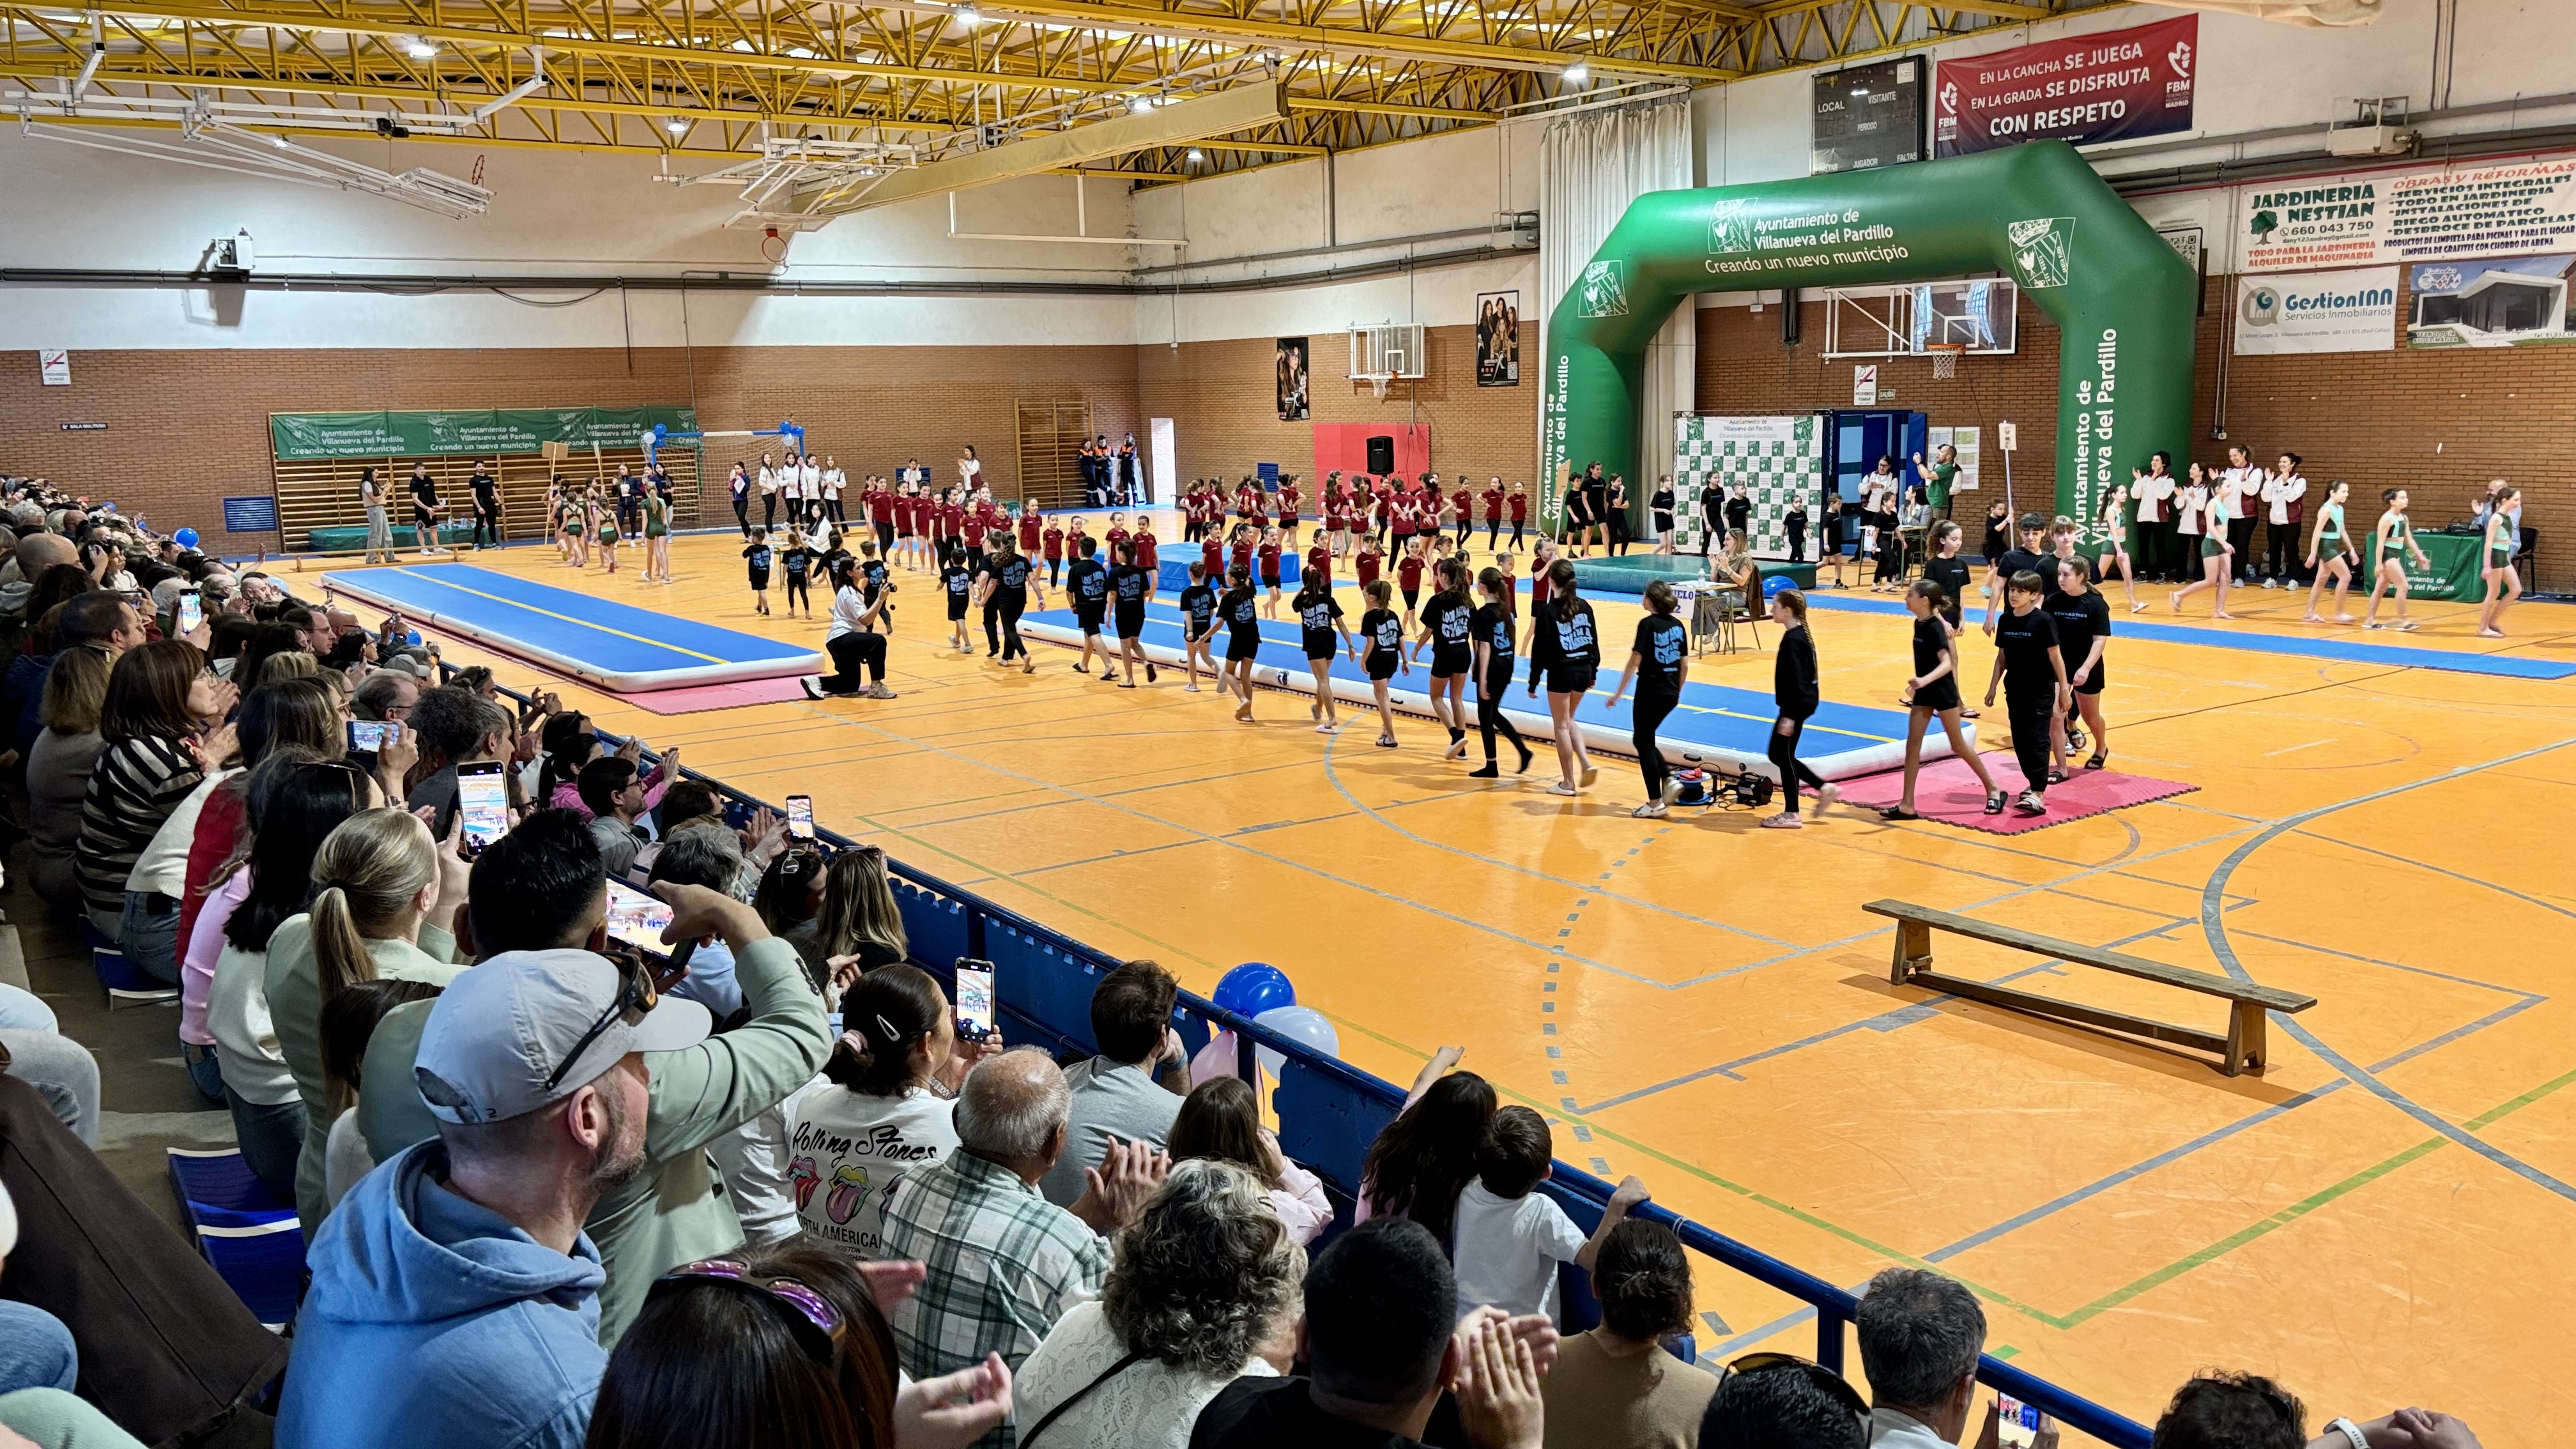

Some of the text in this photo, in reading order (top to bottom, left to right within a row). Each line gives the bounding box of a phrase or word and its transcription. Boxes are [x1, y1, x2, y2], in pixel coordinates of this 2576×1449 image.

[1980, 42, 2143, 84] EN LA CANCHA SE JUEGA
[1971, 66, 2150, 110] EN LA GRADA SE DISFRUTA
[2166, 79, 2190, 94] FBM
[1867, 91, 1896, 104] VISITANTE
[2165, 100, 2189, 108] MADRID
[1818, 100, 1846, 114] LOCAL
[1857, 121, 1878, 132] PERIODO
[1938, 116, 1957, 128] FBM
[1990, 99, 2126, 136] CON RESPETO
[1853, 158, 1878, 169] JUGADOR
[1896, 151, 1918, 162] FALTAS
[2393, 175, 2451, 189] OBRAS
[2472, 163, 2575, 181] REFORMAS
[2478, 174, 2572, 190] INTEGRALES
[2251, 184, 2375, 210] JARDINERIA
[2441, 194, 2459, 203] EN
[2462, 186, 2554, 201] JARDINERIA
[2512, 197, 2533, 206] DE
[1754, 208, 1860, 234] Ayuntamiento de
[2288, 201, 2375, 223] NESTIAN
[2393, 207, 2545, 227] RIEGO AUTOMATICO
[2474, 220, 2492, 229] DE
[2496, 213, 2575, 227] PARCELAS
[1753, 234, 1817, 250] Villanueva
[1820, 229, 1840, 245] del
[1843, 224, 1894, 243] Pardillo
[2291, 220, 2373, 236] 660 043 750
[2384, 237, 2423, 248] PRODUCTOS
[2434, 234, 2465, 243] LIMPIEZA
[2467, 232, 2485, 241] PARA
[2515, 230, 2518, 238] Y
[2520, 228, 2538, 237] PARA
[2550, 225, 2575, 234] HOGAR
[2248, 240, 2376, 258] TODO PARA LA JARDINERIA
[2402, 247, 2432, 256] LIMPIEZA
[2434, 245, 2442, 254] DE
[2475, 242, 2488, 251] CON
[2490, 240, 2519, 250] CHORRO
[2520, 239, 2530, 247] DE
[2531, 238, 2554, 246] ARENA
[1705, 245, 1908, 273] Creando un nuevo municipio
[2248, 251, 2373, 267] ALQUILER DE MAQUINARIA
[2285, 288, 2393, 310] GestionINN
[2285, 308, 2392, 321] Servicios Inmobiliarios
[2095, 328, 2117, 440] del Pardillo
[1555, 355, 1570, 441] del Pardillo
[459, 426, 507, 434] Ayuntamiento
[366, 445, 405, 454] municipio
[430, 443, 463, 451] Creando
[500, 441, 536, 450] municipio
[1542, 393, 1555, 520] Ayuntamiento de
[2074, 379, 2091, 546] Ayuntamiento de
[2437, 576, 2446, 584] de
[793, 1121, 937, 1169] Rolling Stones
[822, 1224, 882, 1249] AMERICA
